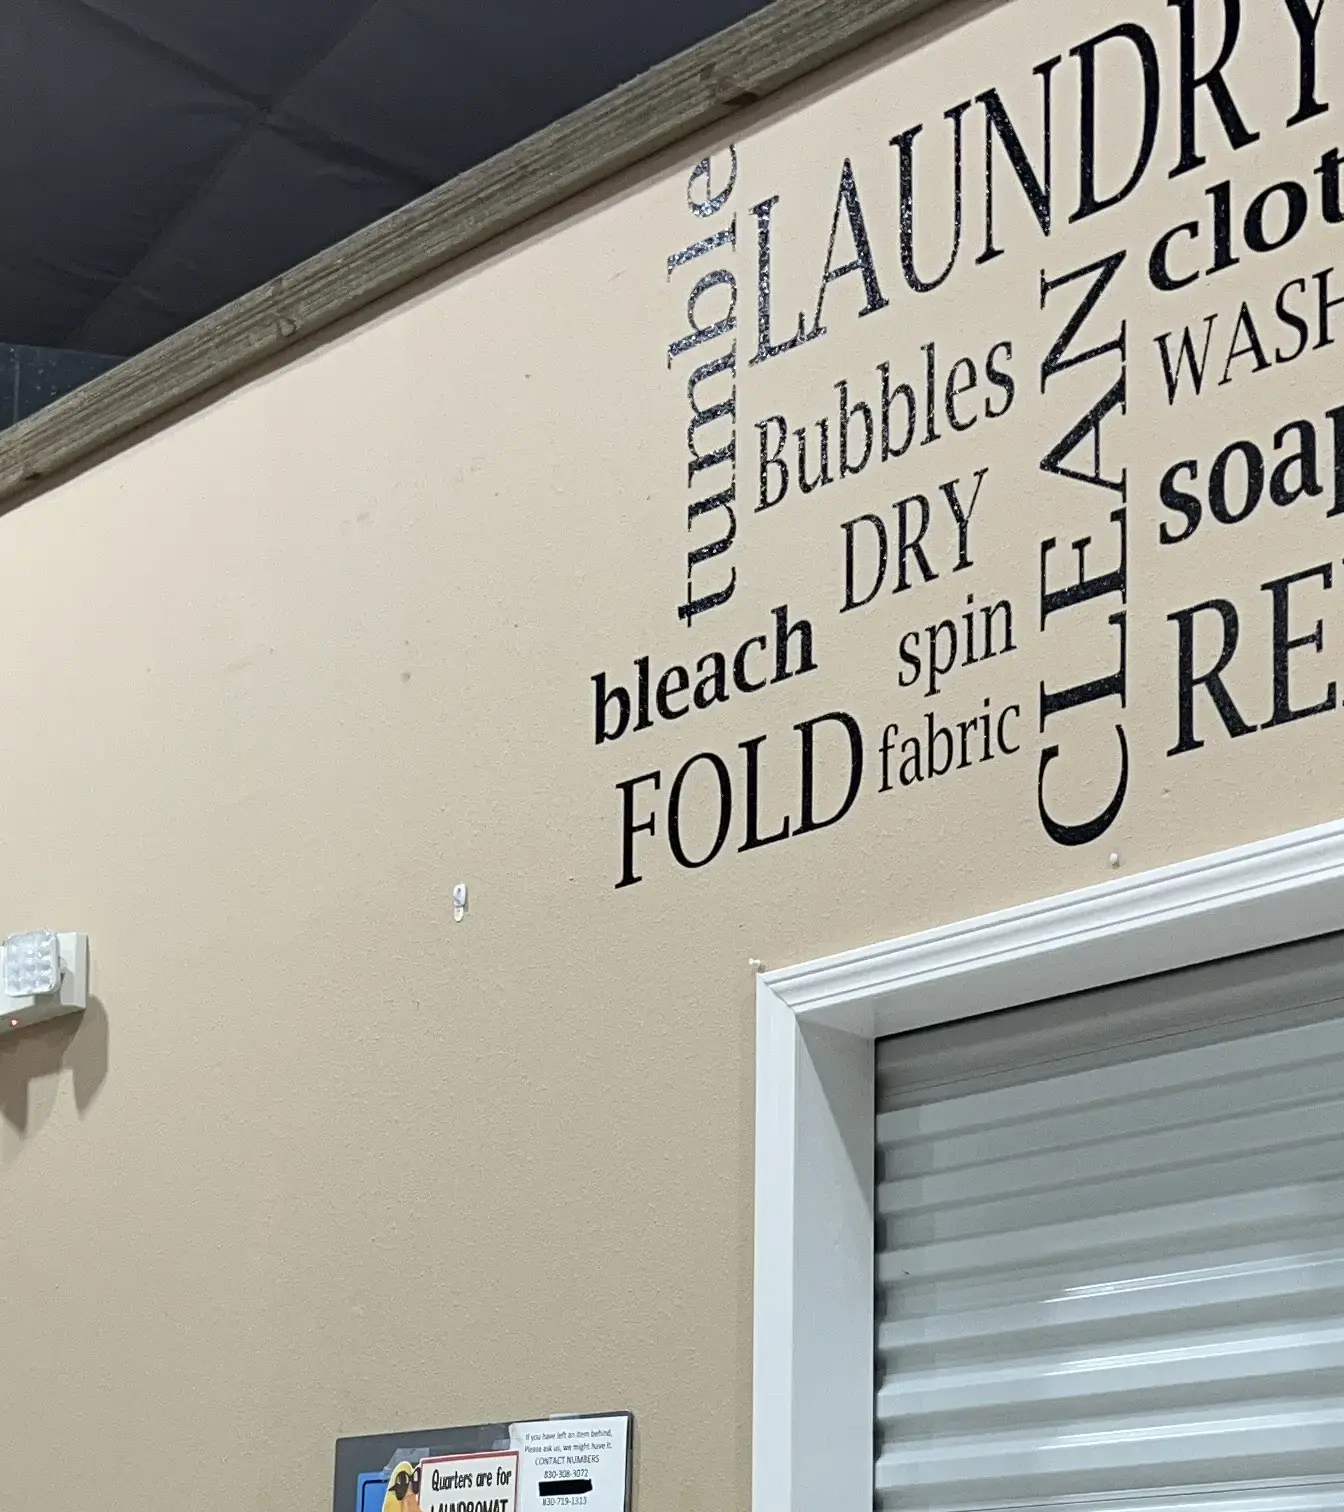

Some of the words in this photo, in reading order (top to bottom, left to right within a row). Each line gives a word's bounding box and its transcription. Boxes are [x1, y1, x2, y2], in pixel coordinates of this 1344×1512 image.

[747, 0, 1330, 368] LAUNDRY
[666, 142, 737, 628] tumble
[753, 338, 1015, 513] Bubbles
[840, 468, 990, 614] DRY
[1039, 249, 1129, 847] CLEAN
[592, 604, 819, 745] bleach
[897, 595, 1016, 696] spin
[613, 708, 864, 890] FOLD
[876, 695, 1023, 794] fabric
[432, 1469, 473, 1491] Quarters
[476, 1473, 493, 1487] are
[496, 1466, 512, 1485] for
[535, 1456, 565, 1466] CONTACT
[566, 1455, 600, 1465] NUMBERS
